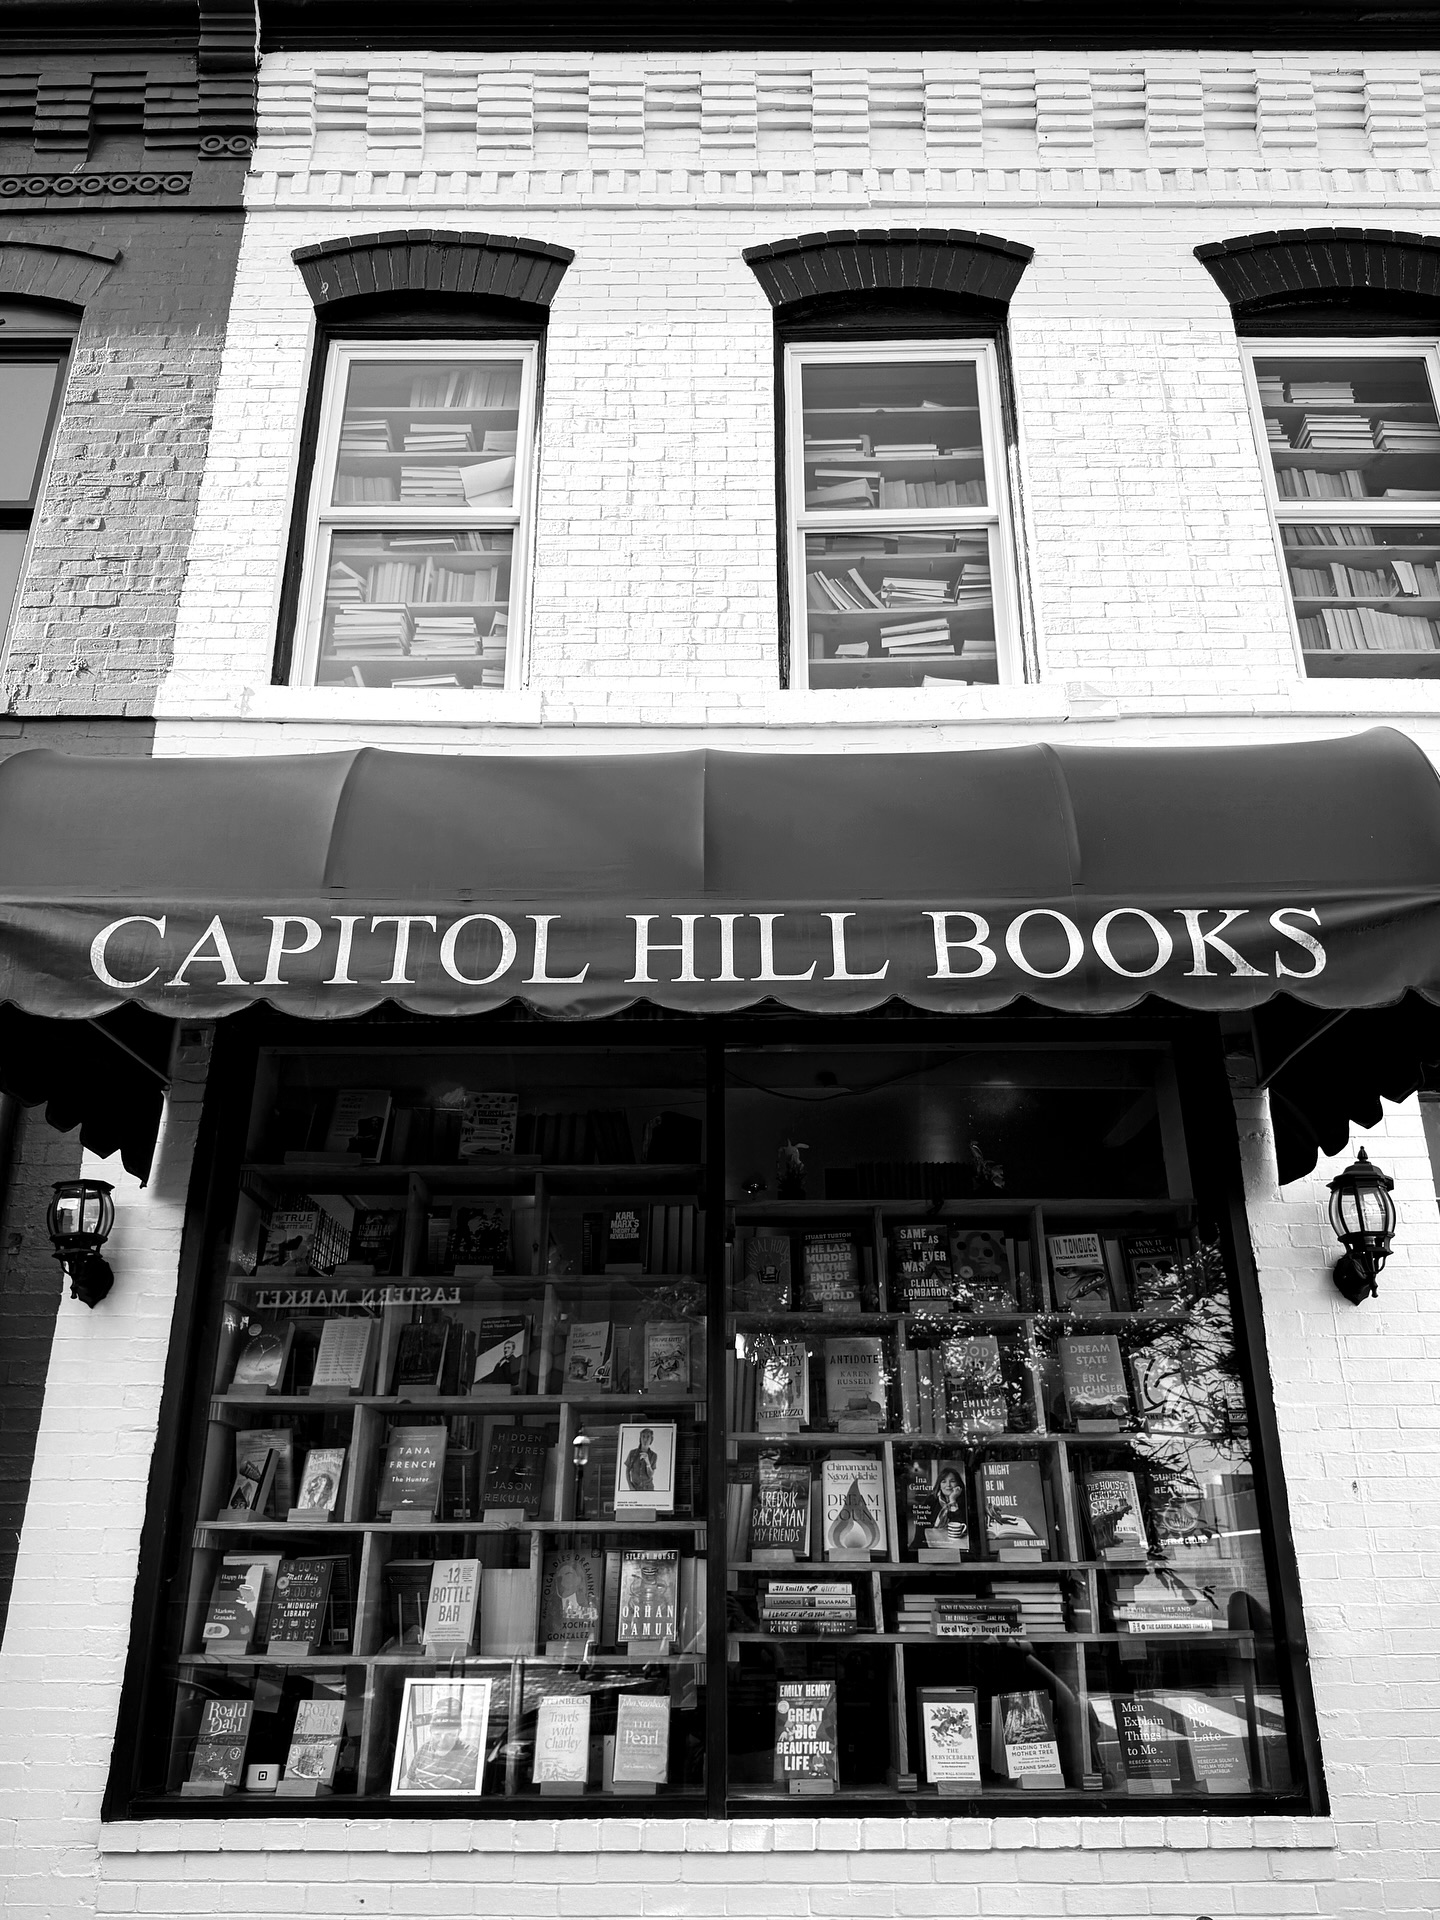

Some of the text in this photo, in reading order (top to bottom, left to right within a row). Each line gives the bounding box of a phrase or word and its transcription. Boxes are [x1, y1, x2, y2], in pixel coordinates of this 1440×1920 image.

[89, 907, 1327, 990] CAPITOL HILL BOOKS
[284, 1213, 313, 1222] TRUE
[616, 1211, 636, 1221] KARL
[610, 1219, 640, 1229] MARX'S
[900, 1228, 927, 1239] SAME
[928, 1235, 939, 1244] AS
[805, 1242, 852, 1254] THE LAST
[913, 1242, 922, 1250] IT
[1053, 1237, 1098, 1255] IN TONGUES
[806, 1252, 852, 1263] MURDER
[922, 1250, 946, 1262] EVER
[811, 1262, 847, 1272] AT THE
[902, 1261, 926, 1272] WAS
[810, 1272, 850, 1282] END OF
[820, 1282, 840, 1291] THE
[910, 1279, 939, 1288] CLAIRE
[813, 1291, 854, 1300] WORLD
[904, 1288, 948, 1298] LOMBARDO
[764, 1345, 798, 1358] SALLY
[1070, 1344, 1110, 1354] DREAM
[830, 1354, 879, 1364] ANTIDOTE
[1076, 1356, 1108, 1365] STATE
[1082, 1374, 1108, 1383] ERIC
[1070, 1384, 1124, 1395] PUCHNER
[962, 1399, 990, 1408] EMILY
[757, 1409, 804, 1418] INTERMEZZO
[390, 1460, 436, 1468] FRENCH
[826, 1462, 878, 1472] Chimamanda
[983, 1464, 1010, 1476] I MIGHT
[827, 1472, 878, 1482] Ngozi Adichie
[492, 1482, 532, 1490] JASON
[985, 1480, 1004, 1491] BE IN
[1099, 1480, 1126, 1491] HOUSE
[484, 1494, 538, 1504] REKULAK
[760, 1490, 798, 1508] FREDRIK
[828, 1494, 880, 1506] DREAM
[986, 1496, 1018, 1506] TROUBLE
[752, 1508, 804, 1527] BACKMAN
[828, 1508, 881, 1522] COUNT
[753, 1528, 800, 1542] MY FRIENDS
[286, 1572, 304, 1581] Matt
[304, 1573, 319, 1584] Haig
[447, 1567, 461, 1584] 12
[544, 1572, 554, 1596] OLGA
[552, 1554, 571, 1568] DIES
[432, 1586, 472, 1604] BOTTLE
[286, 1602, 319, 1610] MIDNIGHT
[622, 1605, 674, 1618] ORHAN
[438, 1605, 460, 1622] BAR
[621, 1622, 674, 1636] PAMUK
[941, 1625, 951, 1634] Age
[958, 1625, 970, 1633] Vice
[981, 1624, 1000, 1634] Deepti
[547, 1632, 590, 1641] GONZALEZ
[780, 1684, 831, 1698] EMILY HENRY
[208, 1702, 248, 1720] Roald
[1120, 1702, 1144, 1712] Men
[550, 1710, 580, 1723] Travels
[788, 1708, 824, 1722] GREAT
[210, 1717, 242, 1734] Dahl
[634, 1720, 651, 1728] THE
[1123, 1716, 1164, 1728] Explain
[1190, 1717, 1212, 1728] Too
[552, 1726, 574, 1736] with
[794, 1724, 817, 1740] BIG
[1124, 1730, 1161, 1742] Things
[1192, 1731, 1222, 1742] Late
[626, 1730, 658, 1745] Pearl
[544, 1736, 582, 1754] Charley
[776, 1741, 832, 1754] BEAUTIFUL
[1127, 1744, 1158, 1756] to Me
[784, 1756, 810, 1771] LIFE
